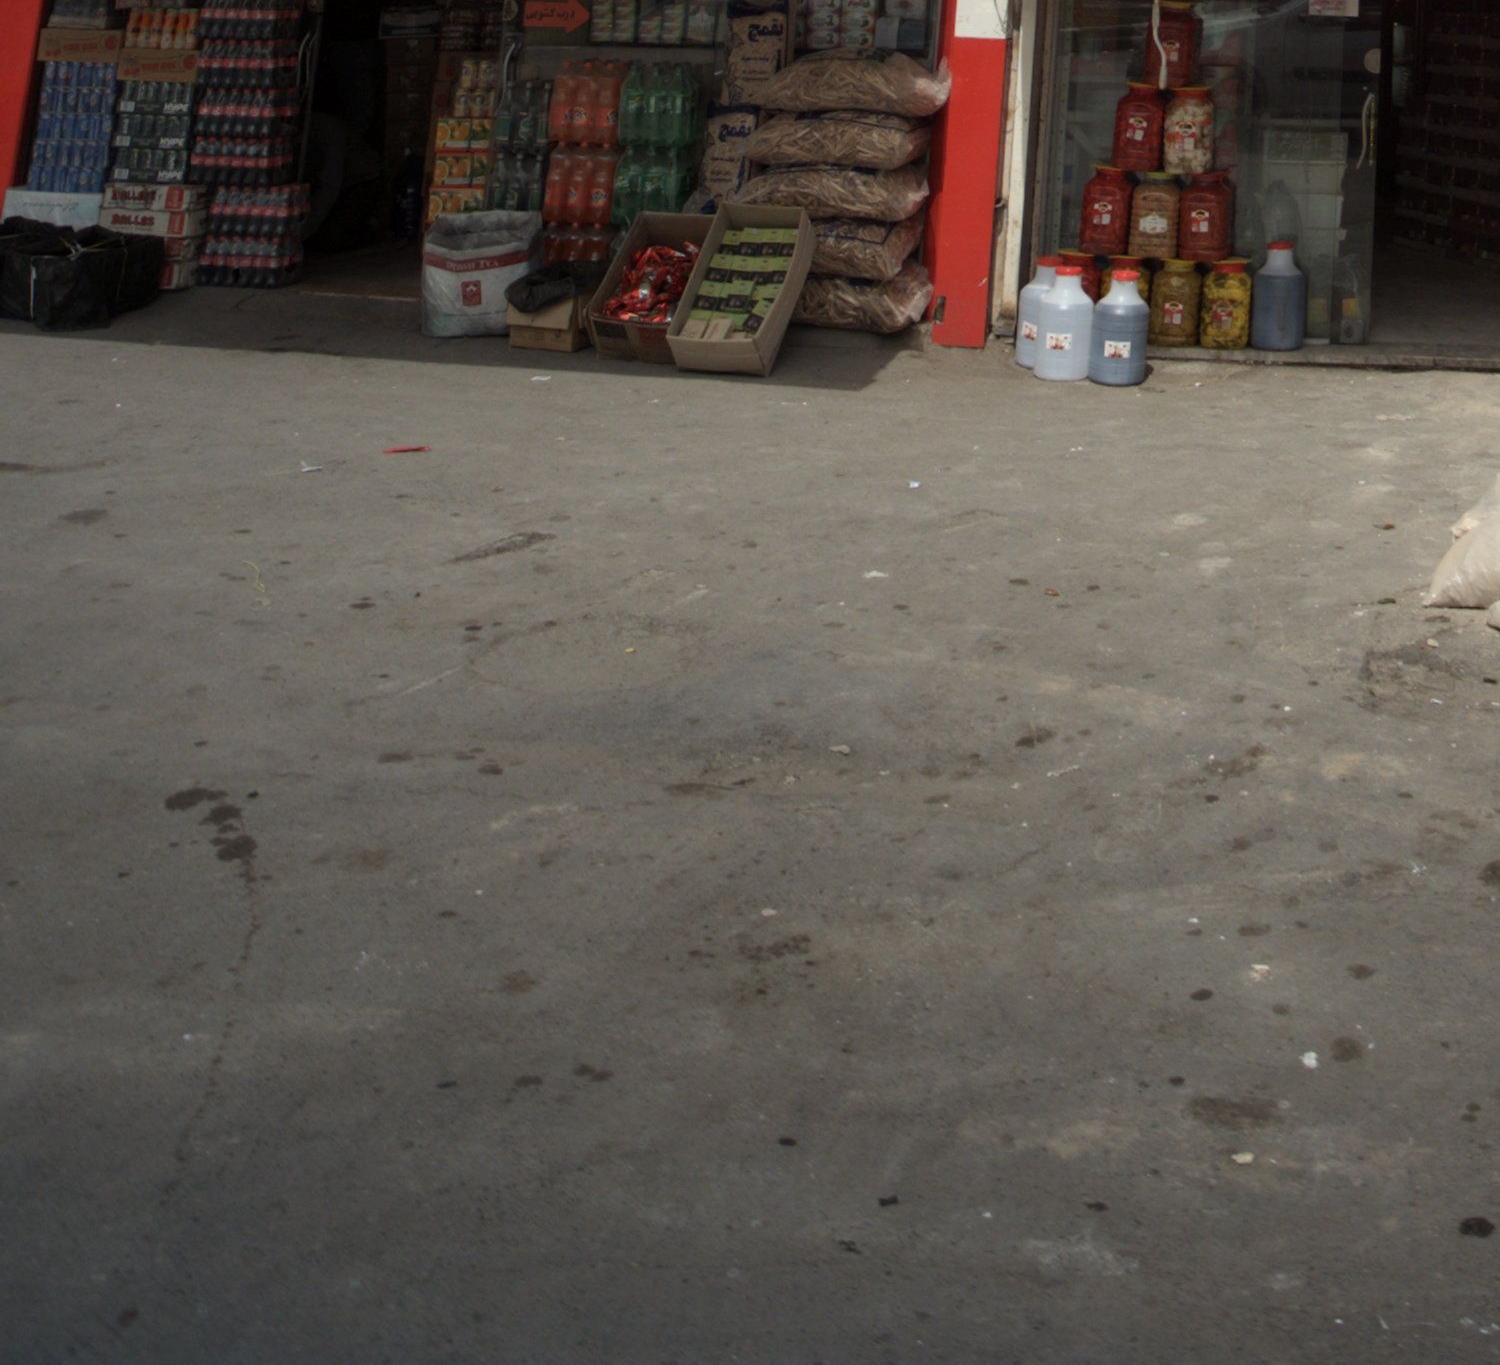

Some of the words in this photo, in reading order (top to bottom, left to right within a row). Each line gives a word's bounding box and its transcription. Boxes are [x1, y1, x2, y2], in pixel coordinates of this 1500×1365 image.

[163, 102, 190, 113] HYPE
[159, 137, 186, 148] HYPE
[157, 170, 184, 181] HYPE
